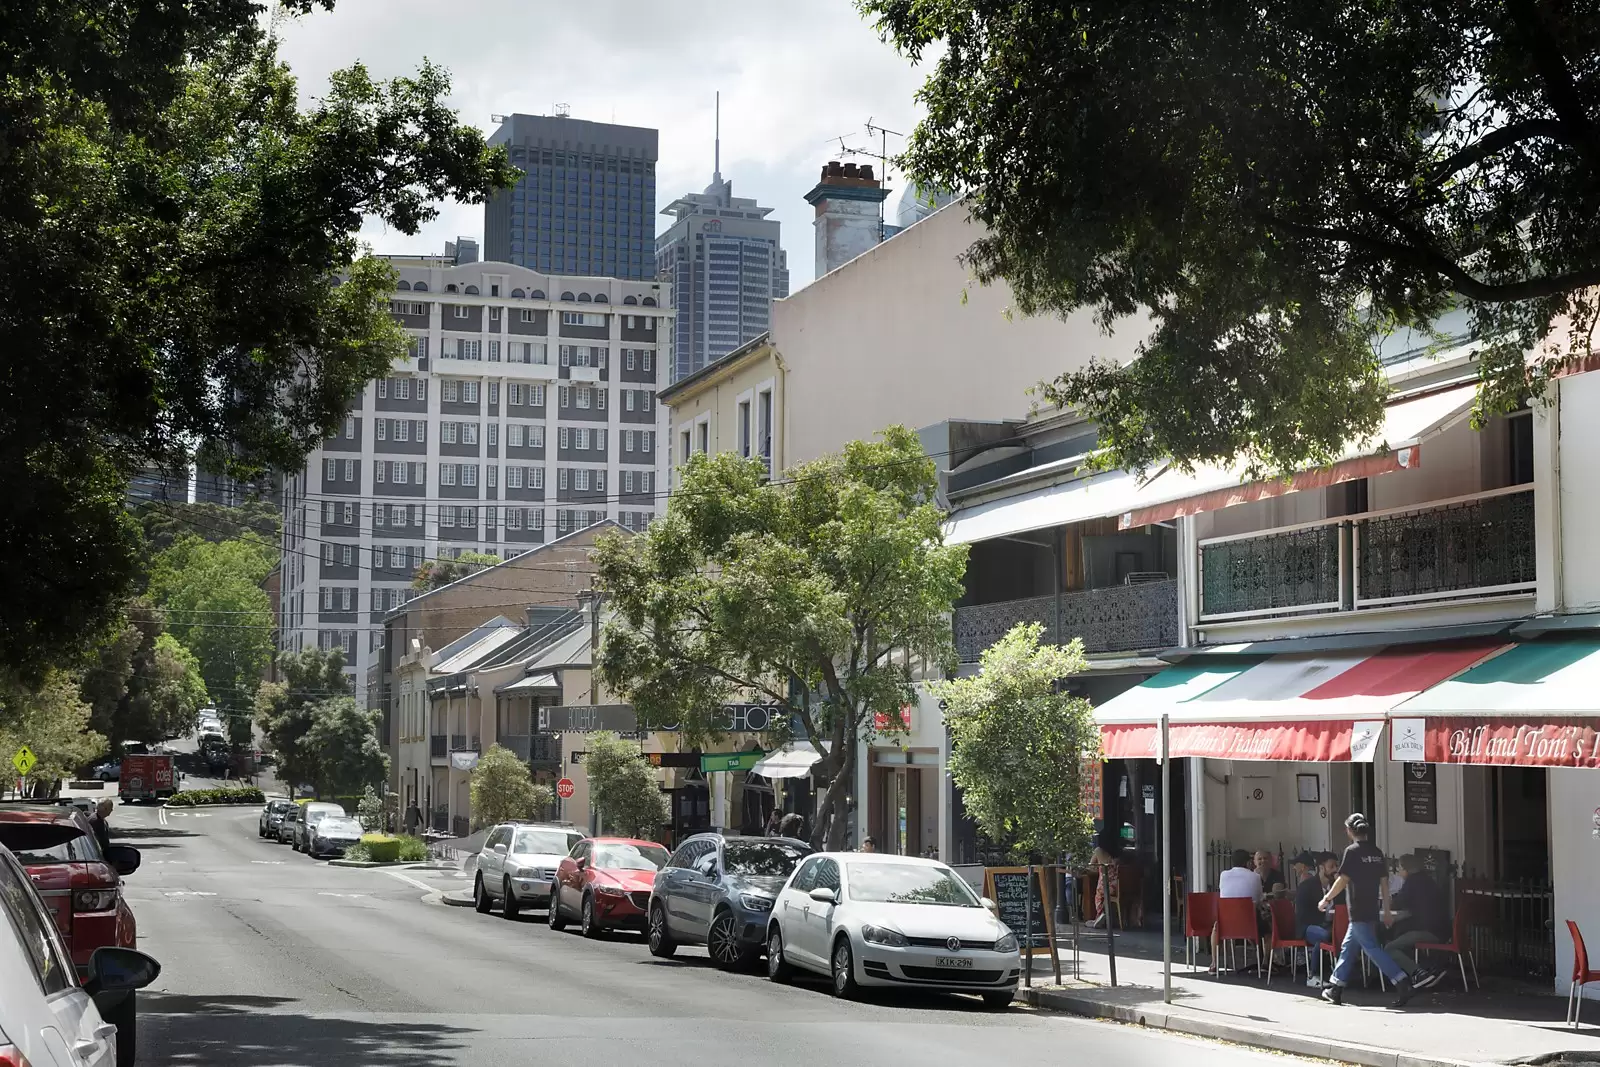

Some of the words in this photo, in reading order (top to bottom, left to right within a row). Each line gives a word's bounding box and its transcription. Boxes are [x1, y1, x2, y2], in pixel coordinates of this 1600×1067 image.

[702, 219, 722, 232] citi
[1228, 730, 1274, 753] Italian
[1395, 742, 1410, 751] BLACK
[1450, 726, 1487, 756] Bill
[1485, 726, 1526, 757] and
[1524, 727, 1584, 758] Toni's
[156, 767, 171, 782] coles
[558, 784, 574, 793] STOP
